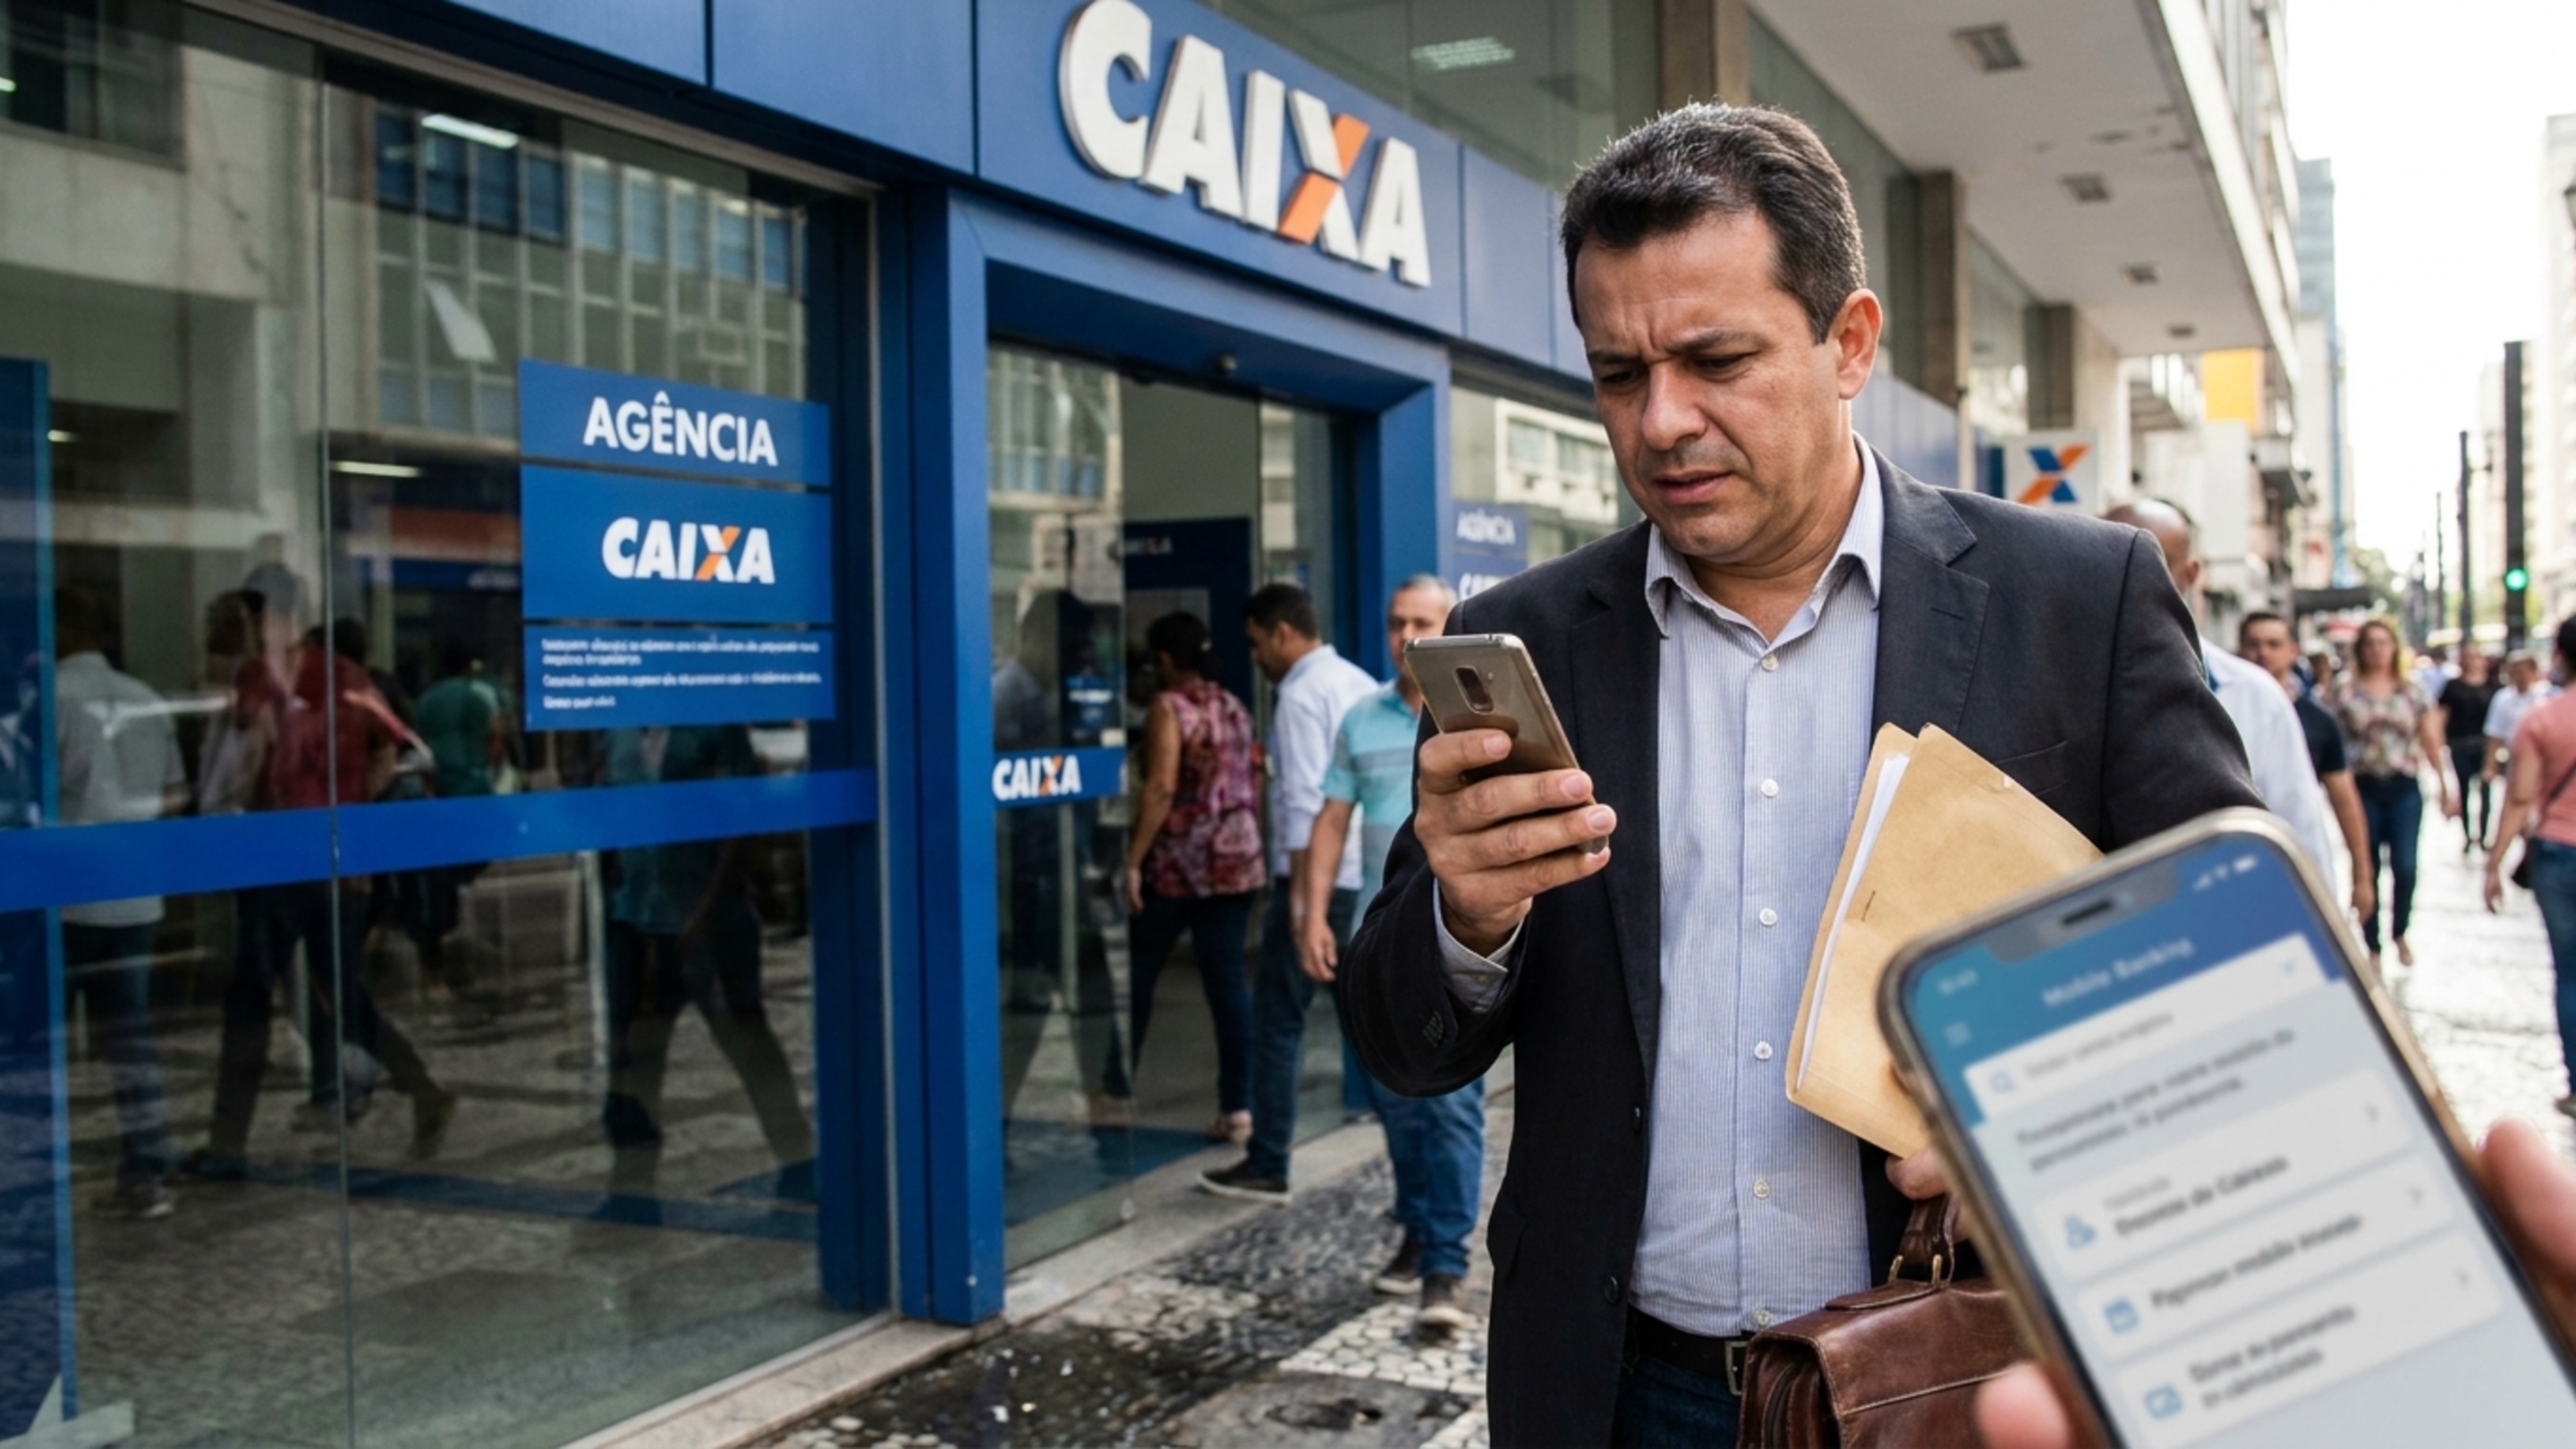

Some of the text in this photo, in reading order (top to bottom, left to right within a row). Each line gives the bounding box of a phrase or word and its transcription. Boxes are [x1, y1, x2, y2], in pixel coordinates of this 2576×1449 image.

[1058, 0, 1431, 288] CAIXA
[583, 391, 778, 466] AGÊNCIA
[602, 518, 775, 584] CAIXA
[992, 755, 1081, 801] CAIXA
